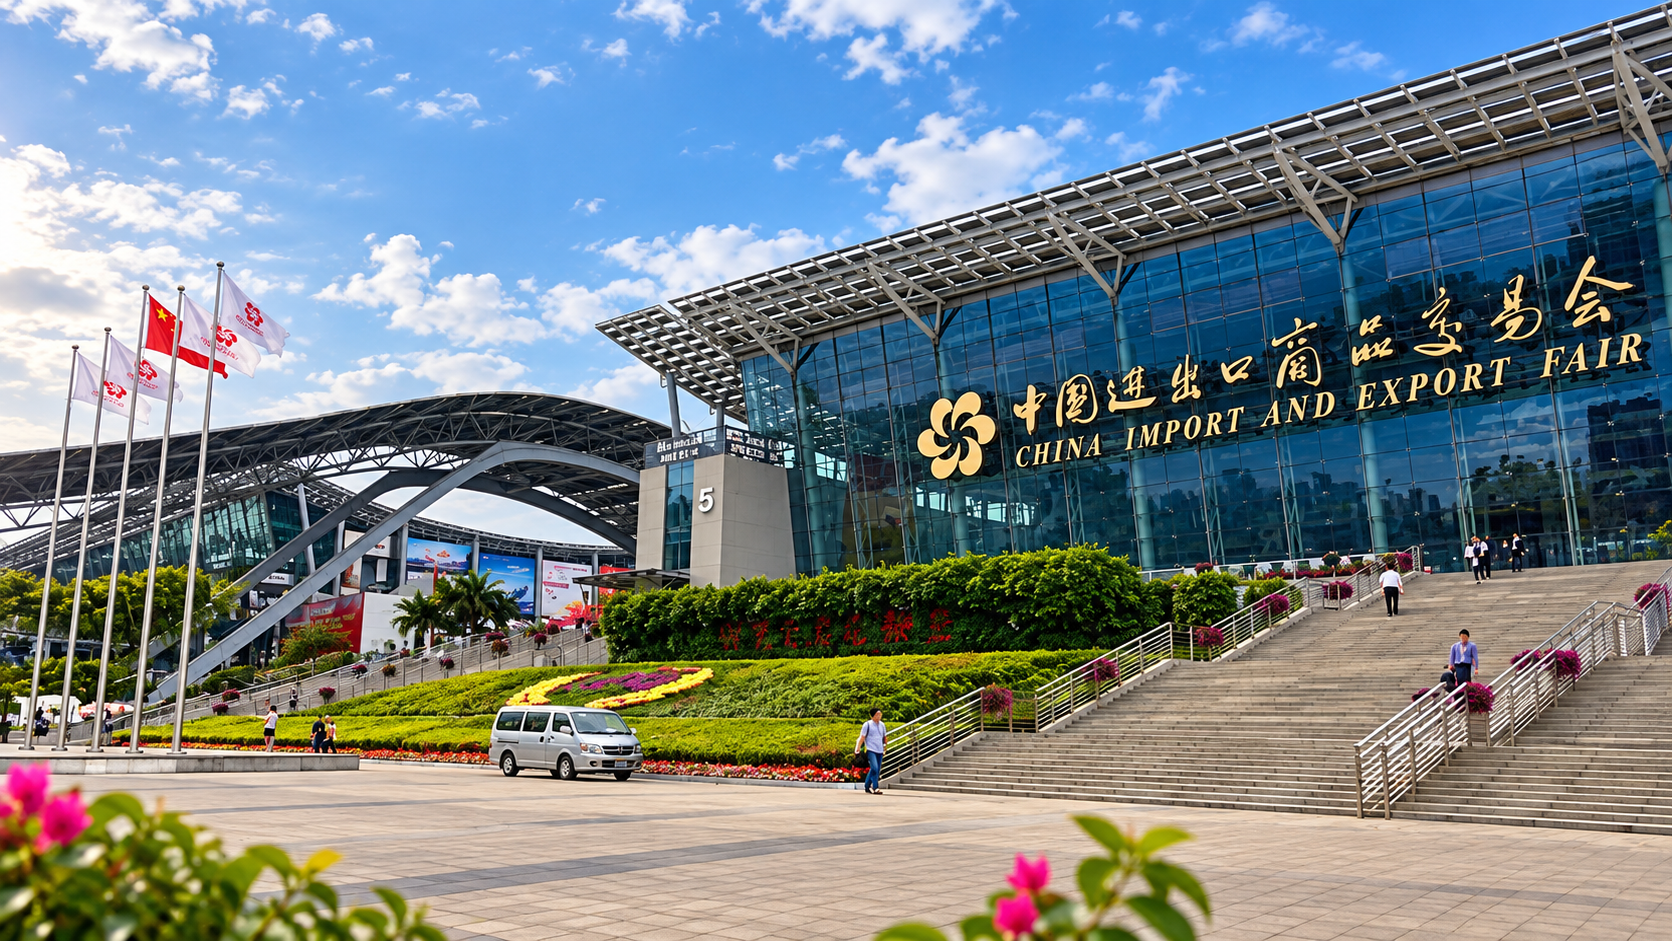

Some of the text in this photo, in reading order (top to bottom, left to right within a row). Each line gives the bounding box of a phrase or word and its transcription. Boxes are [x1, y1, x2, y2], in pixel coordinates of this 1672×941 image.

[1015, 333, 1643, 468] CHINA IMPORT AND EXPORT FAIR
[697, 486, 715, 514] 5
